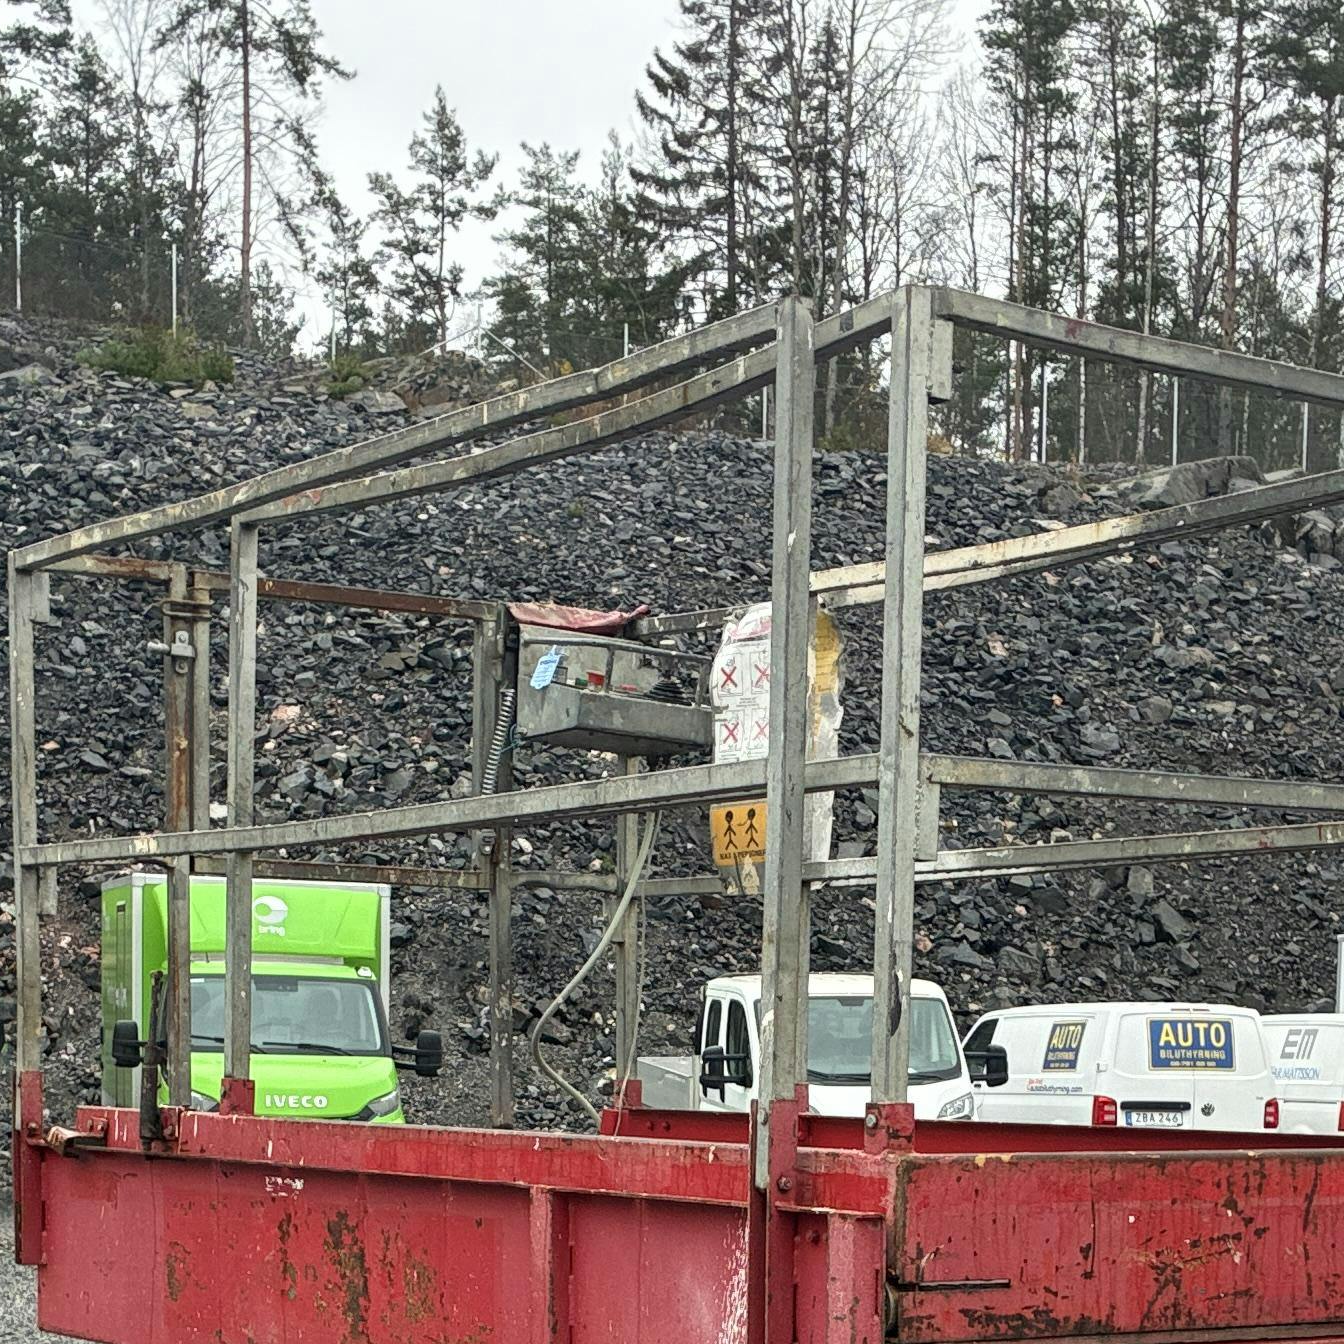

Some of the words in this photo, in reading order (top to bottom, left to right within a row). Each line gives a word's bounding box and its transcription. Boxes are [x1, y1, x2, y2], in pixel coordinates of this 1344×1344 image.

[1049, 1024, 1083, 1050] AUTO
[1159, 1022, 1226, 1048] AUTO
[265, 1094, 328, 1109] IVECO
[1135, 1112, 1156, 1123] ZBA
[1158, 1112, 1179, 1124] 246
